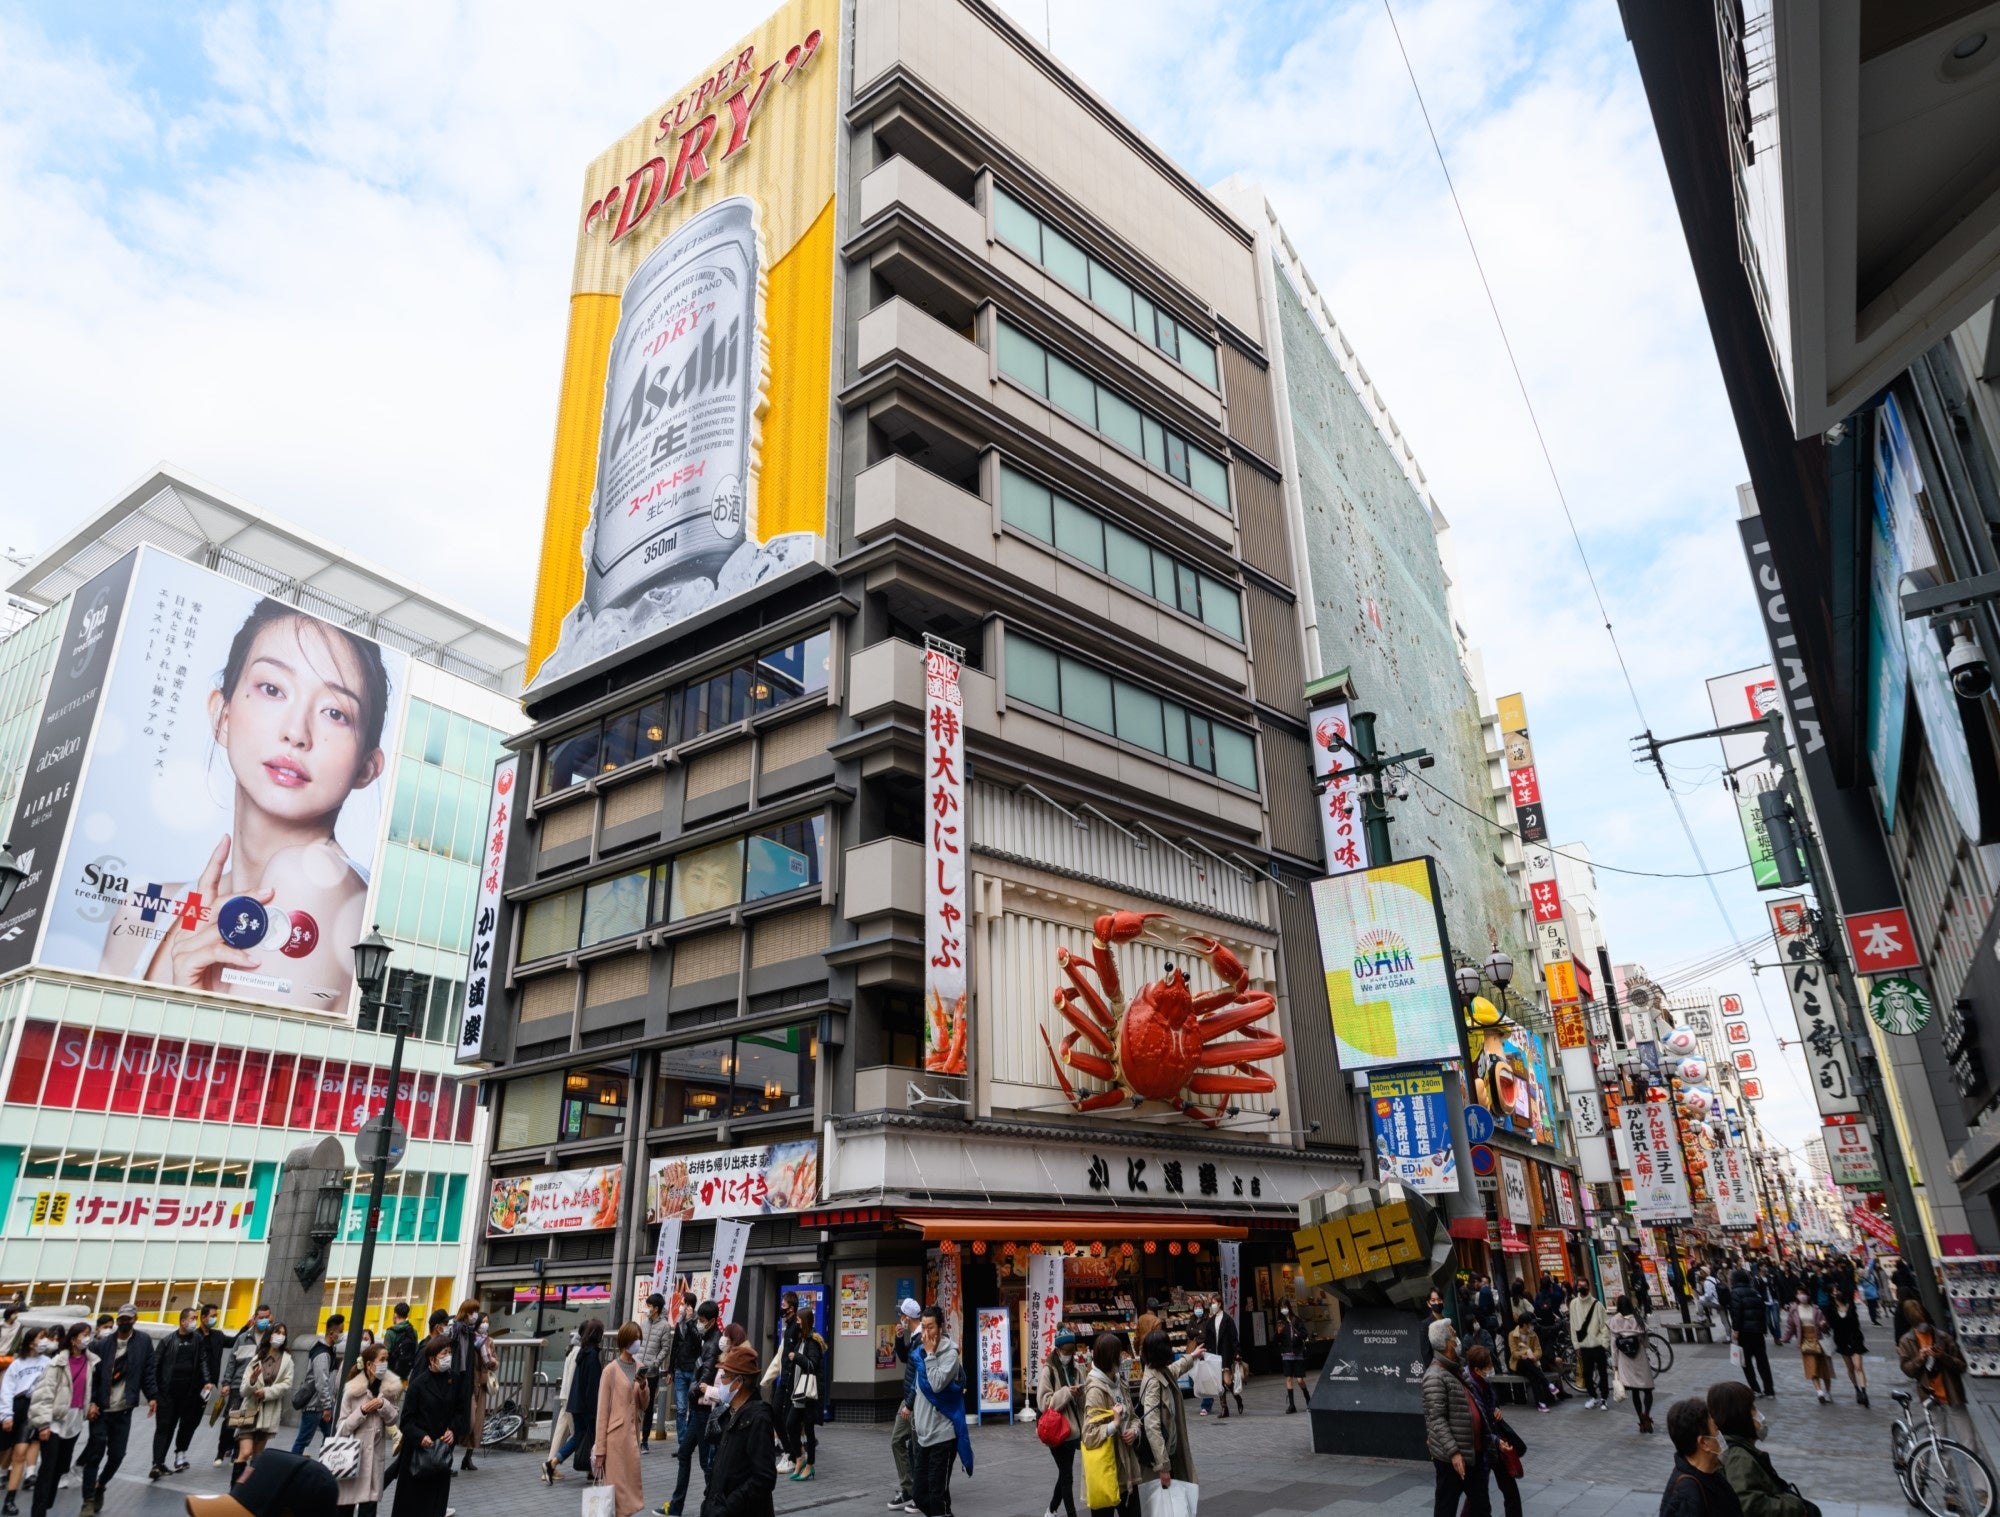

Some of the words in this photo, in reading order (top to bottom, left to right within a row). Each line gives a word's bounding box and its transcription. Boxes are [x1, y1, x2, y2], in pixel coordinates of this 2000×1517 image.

[655, 46, 754, 143] SUPER
[658, 296, 688, 323] JAPAN
[691, 279, 722, 299] BRAND
[610, 314, 740, 463] Asahi
[651, 421, 687, 469] 生
[629, 460, 706, 517] スーパードライ
[646, 491, 679, 522] 生ビール
[713, 492, 741, 524] お酒
[644, 532, 677, 564] 350ml
[79, 605, 109, 641] Spa
[145, 588, 169, 662] エキスパート
[72, 629, 105, 657] treatment
[23, 782, 71, 820] AIRARE
[1316, 759, 1361, 869] 本場の味
[486, 803, 507, 896] 本場の味
[929, 704, 961, 969] 特大かにしゃぶ
[80, 862, 130, 894] Spa
[74, 888, 128, 907] treatment
[133, 891, 171, 914] NMN
[1534, 883, 1557, 919] はや
[1547, 925, 1567, 960] 白木屋
[1858, 923, 1903, 959] 本
[463, 906, 496, 1048] かに道楽
[1353, 946, 1414, 979] OSAKA
[1360, 983, 1373, 992] We
[1375, 982, 1387, 990] are
[1388, 977, 1416, 988] OSAKA
[61, 1041, 227, 1084] SUNDRUG
[313, 1073, 345, 1094] Tax
[351, 1078, 389, 1099] Free
[396, 1082, 437, 1109] Shop
[1372, 1084, 1390, 1092] 340m
[1422, 1079, 1441, 1088] 240m
[530, 1187, 601, 1212] かにしゃぶ会席
[700, 1172, 769, 1207] かにすき
[35, 1194, 67, 1222] 薬
[76, 1195, 227, 1228] サンドラッグ
[1292, 1201, 1423, 1288] 2025
[989, 1314, 1004, 1375] かに料理
